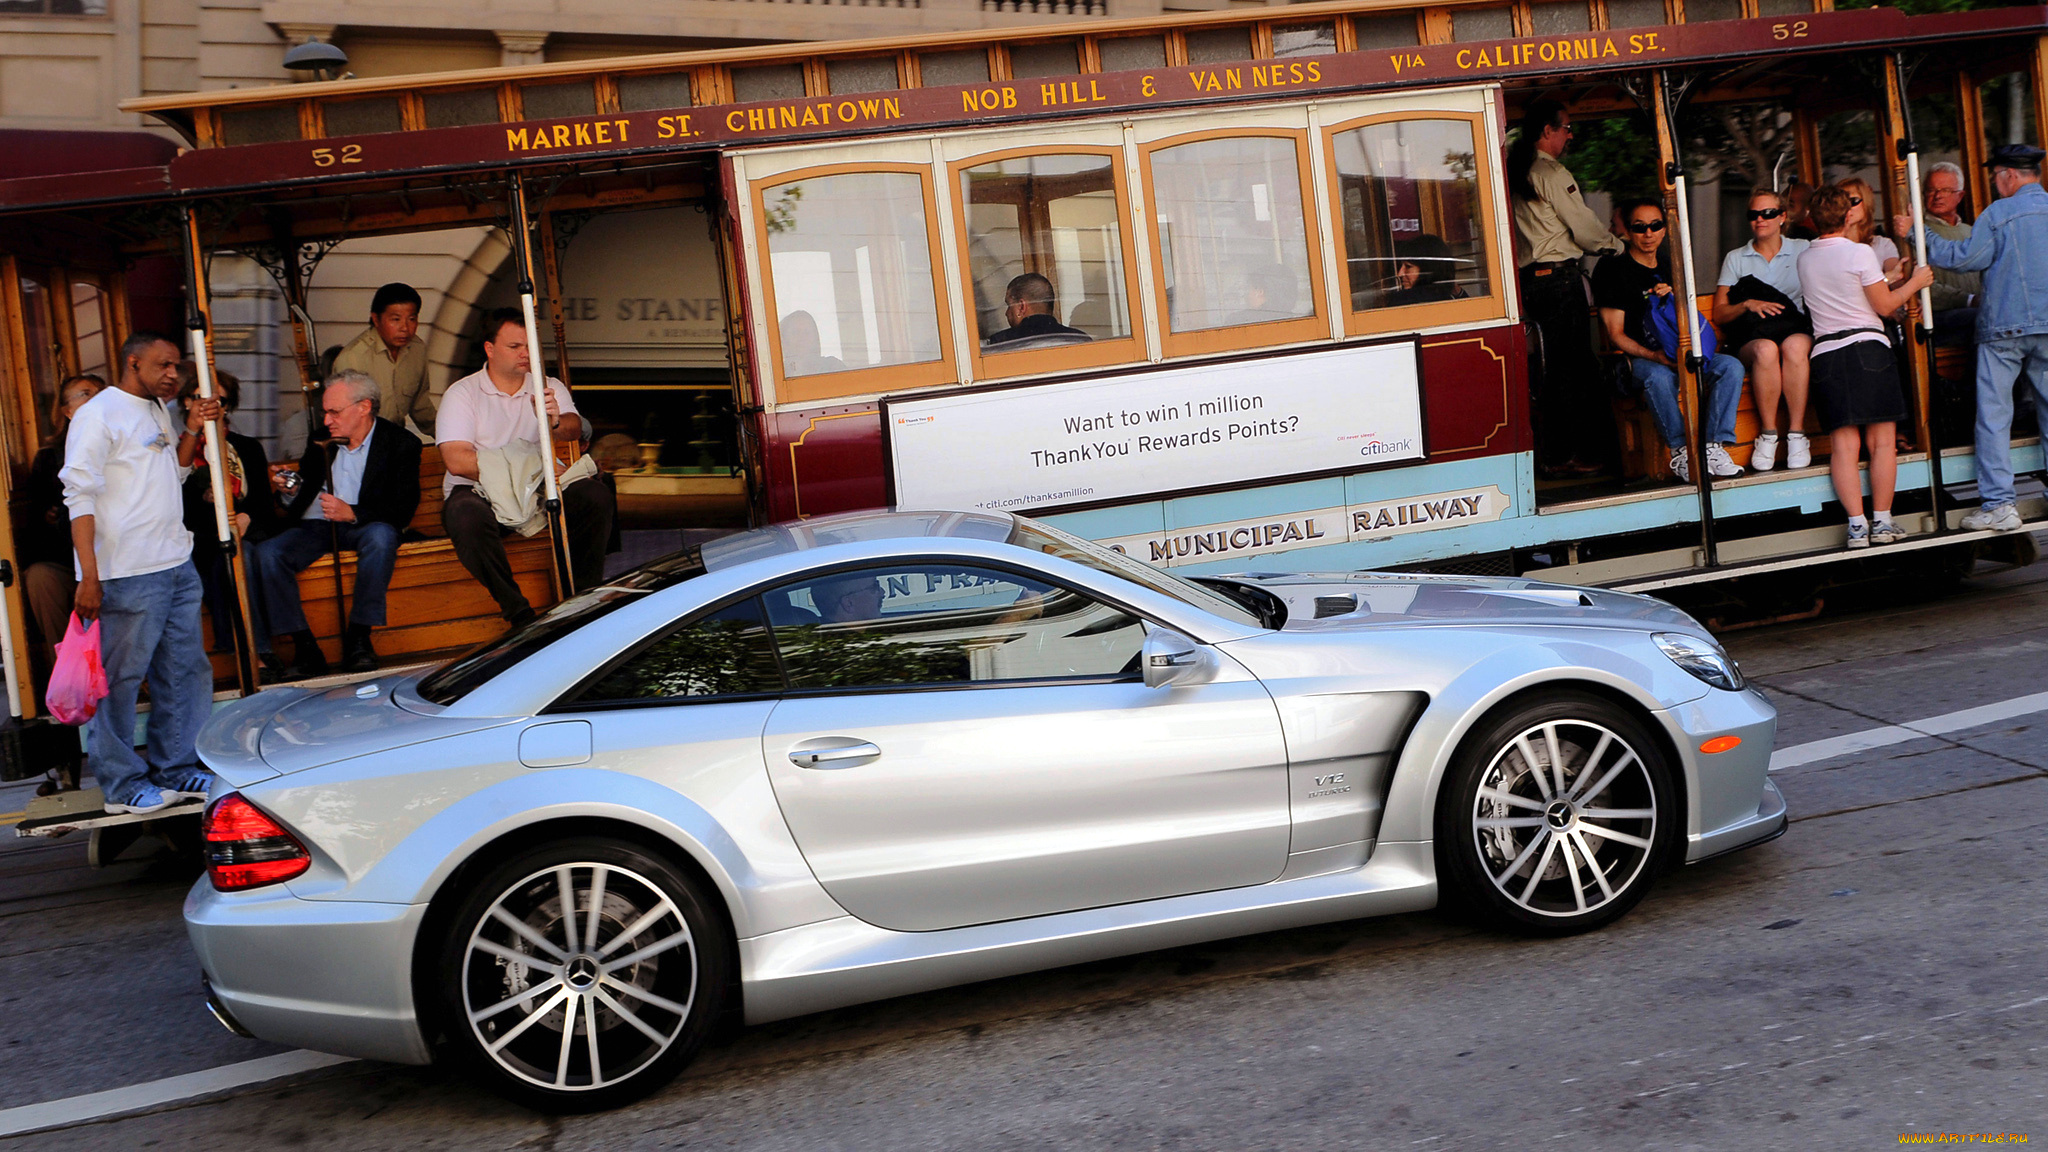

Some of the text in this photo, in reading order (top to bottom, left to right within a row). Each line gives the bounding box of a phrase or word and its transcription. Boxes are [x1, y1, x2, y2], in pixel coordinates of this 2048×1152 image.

[1772, 21, 1809, 41] 52
[506, 120, 630, 151] MARKET
[962, 87, 1018, 112] NOB
[1041, 80, 1106, 105] HILL
[1142, 75, 1157, 97] &
[1189, 68, 1242, 92] VAN
[1252, 61, 1322, 87] NESS
[1456, 37, 1620, 69] CALIFORNIA
[311, 144, 363, 167] 52
[1063, 392, 1264, 435] Want to win 1 million
[1139, 425, 1221, 452] Rewards
[1228, 415, 1300, 440] Points?
[986, 486, 1094, 509] citi.com/thanksamillion
[1150, 494, 1484, 561] MUNICIPAL RAILWAY
[1314, 772, 1345, 787] V12
